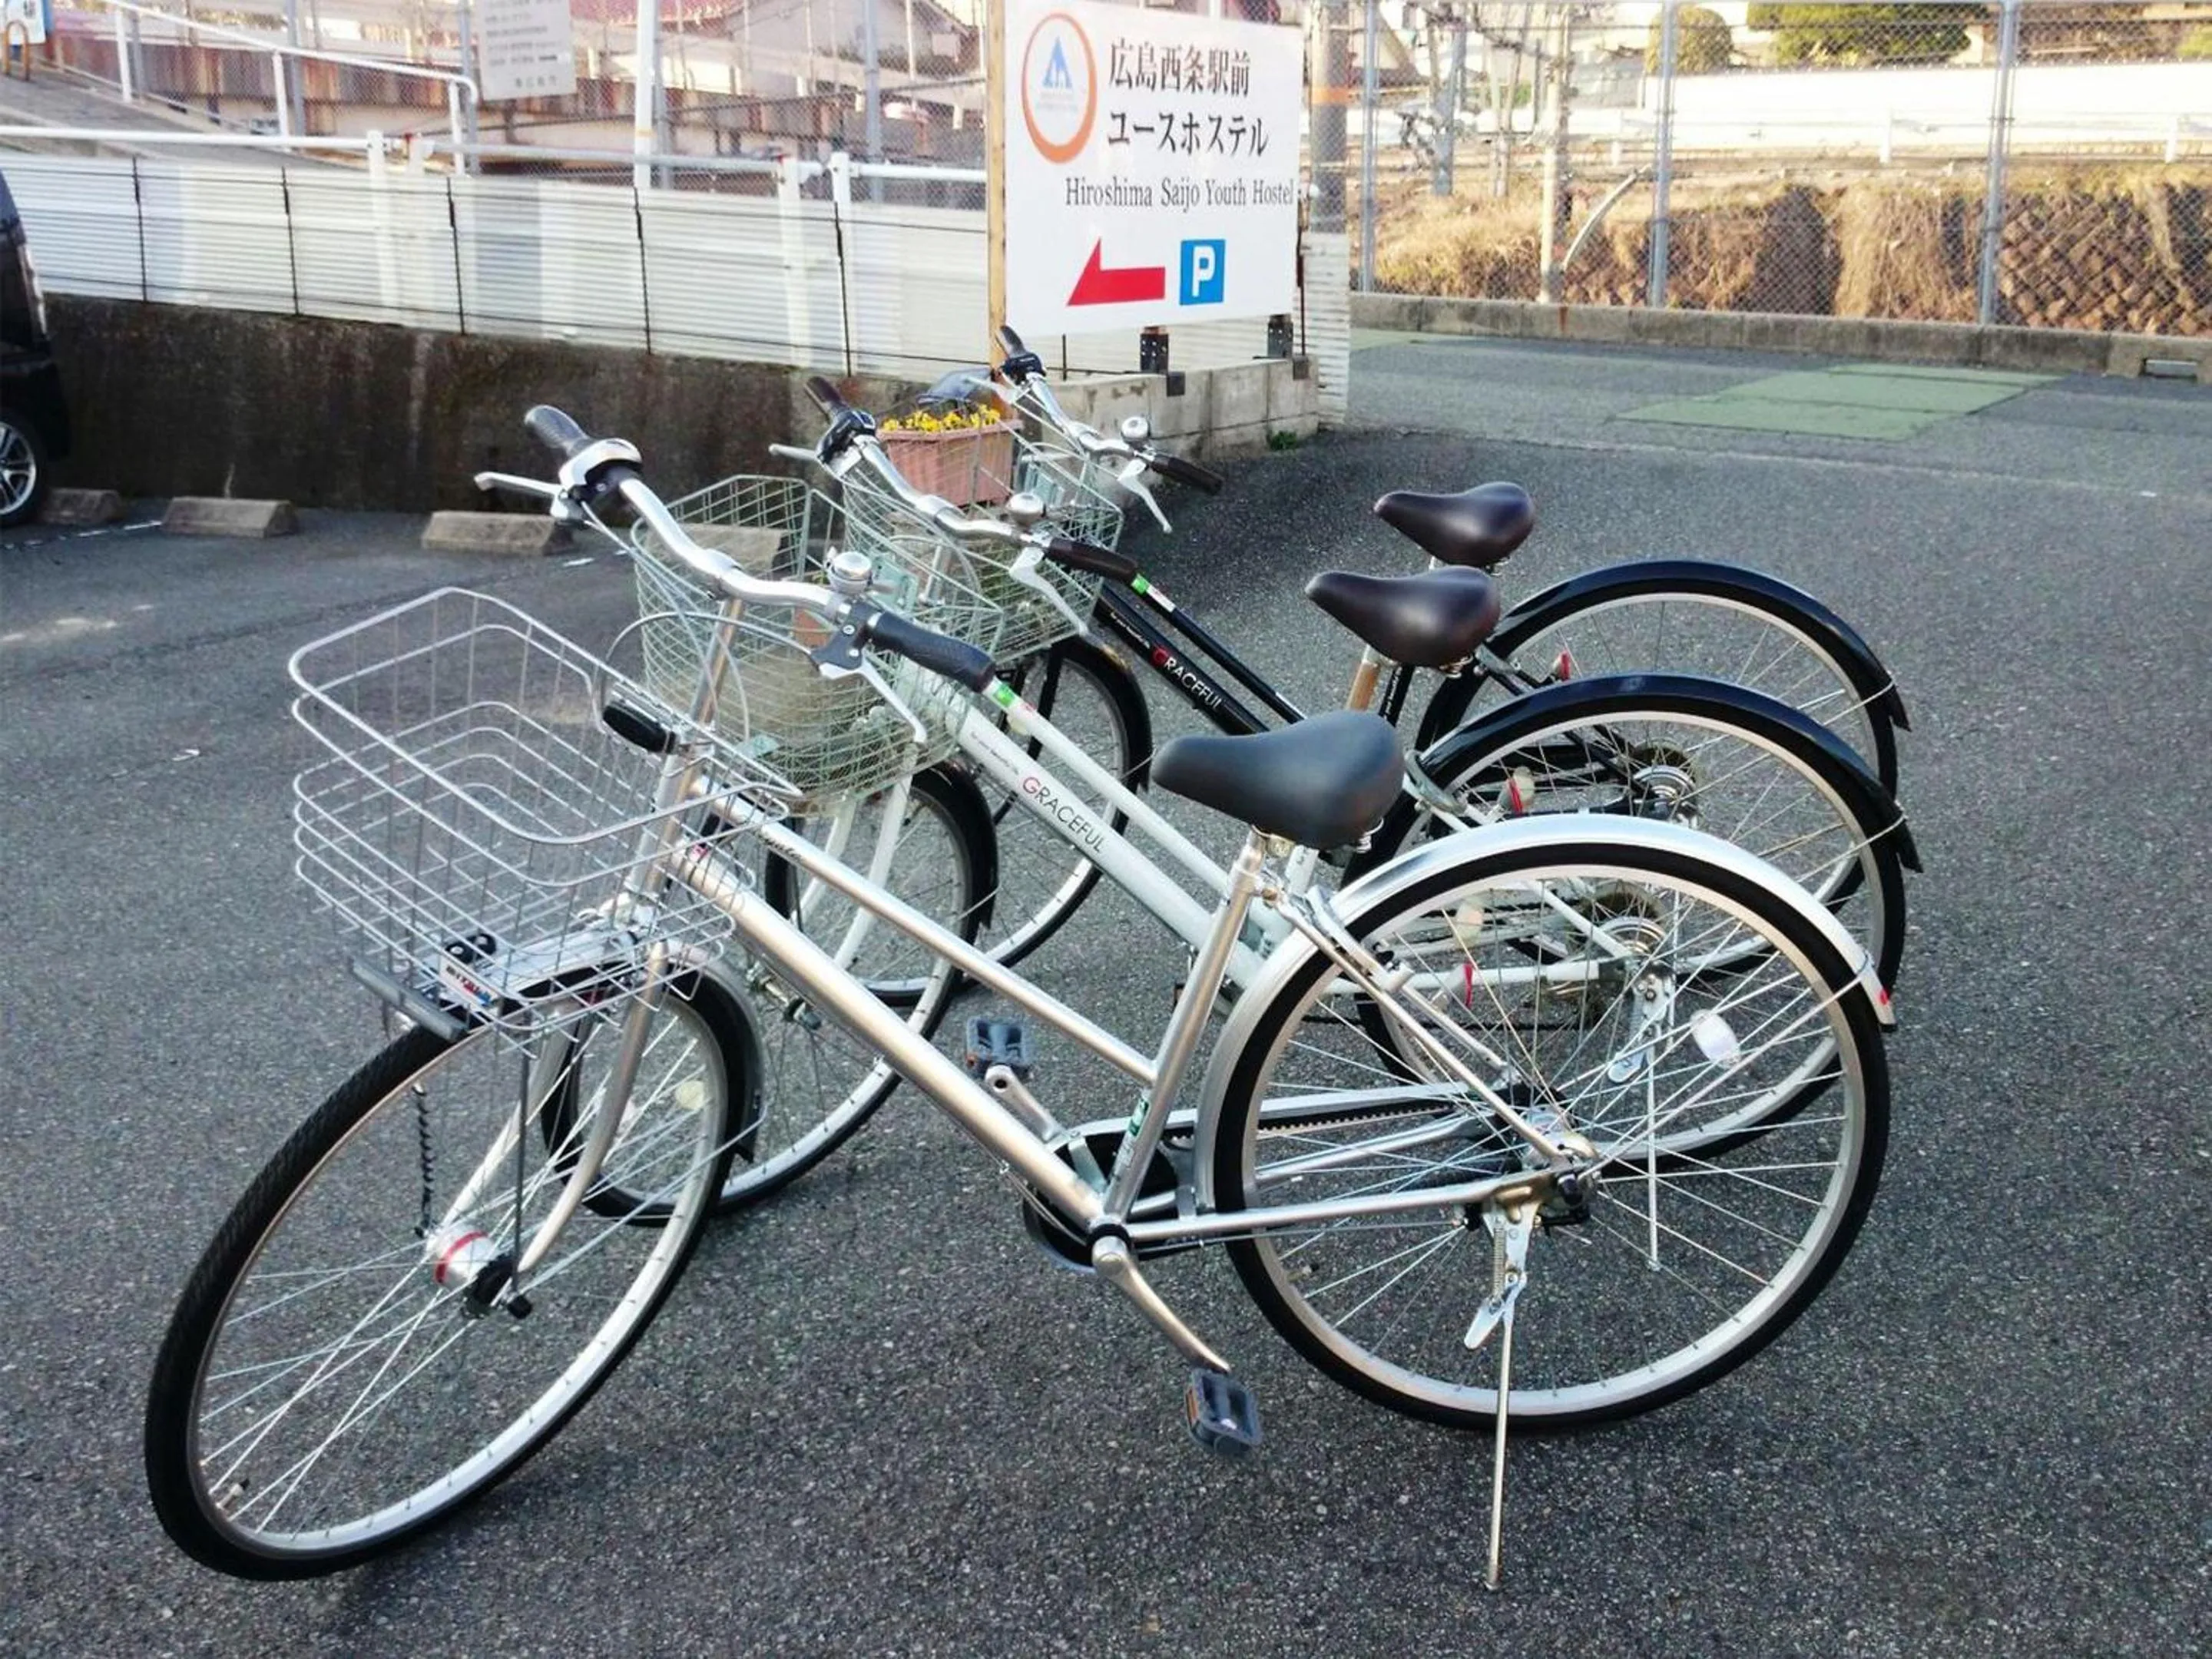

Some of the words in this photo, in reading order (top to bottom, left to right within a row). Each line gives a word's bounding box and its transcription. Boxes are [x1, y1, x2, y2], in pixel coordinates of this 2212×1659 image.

[1108, 38, 1251, 97] 広島西条駅前
[1108, 111, 1269, 157] ユースホステル
[1065, 176, 1152, 207] Hiroshima
[1161, 177, 1200, 213] Saijo
[1205, 177, 1246, 206] Youth
[1253, 178, 1294, 205] Hostel
[1192, 245, 1215, 297] P
[1022, 776, 1106, 853] GRACEFUL
